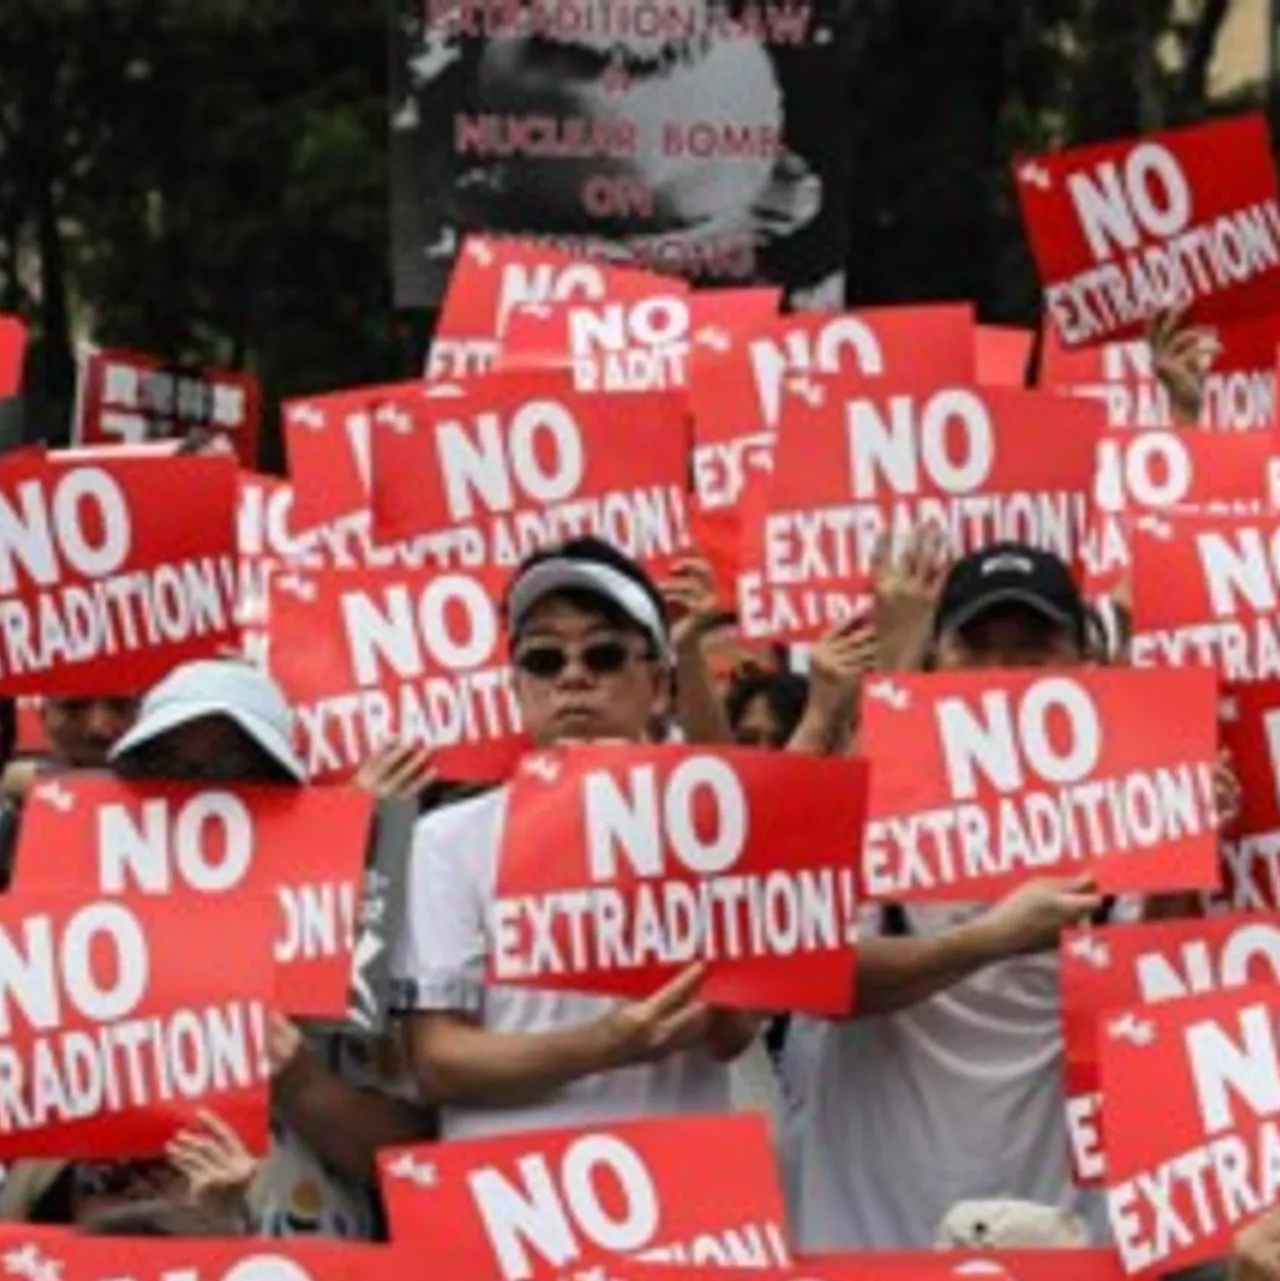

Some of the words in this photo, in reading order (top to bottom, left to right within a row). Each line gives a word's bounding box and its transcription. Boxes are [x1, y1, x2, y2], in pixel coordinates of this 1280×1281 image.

[454, 112, 641, 157] NUCLEAR
[1066, 142, 1192, 260] NO
[568, 296, 690, 351] NO
[434, 400, 584, 522] NO
[846, 388, 995, 497] NO
[339, 575, 497, 688] NO
[933, 676, 1101, 800] NO
[97, 790, 254, 895] NO
[581, 754, 749, 882] NO
[863, 763, 1222, 897] EXTRADITION!
[488, 866, 862, 979] EXTRADITION!
